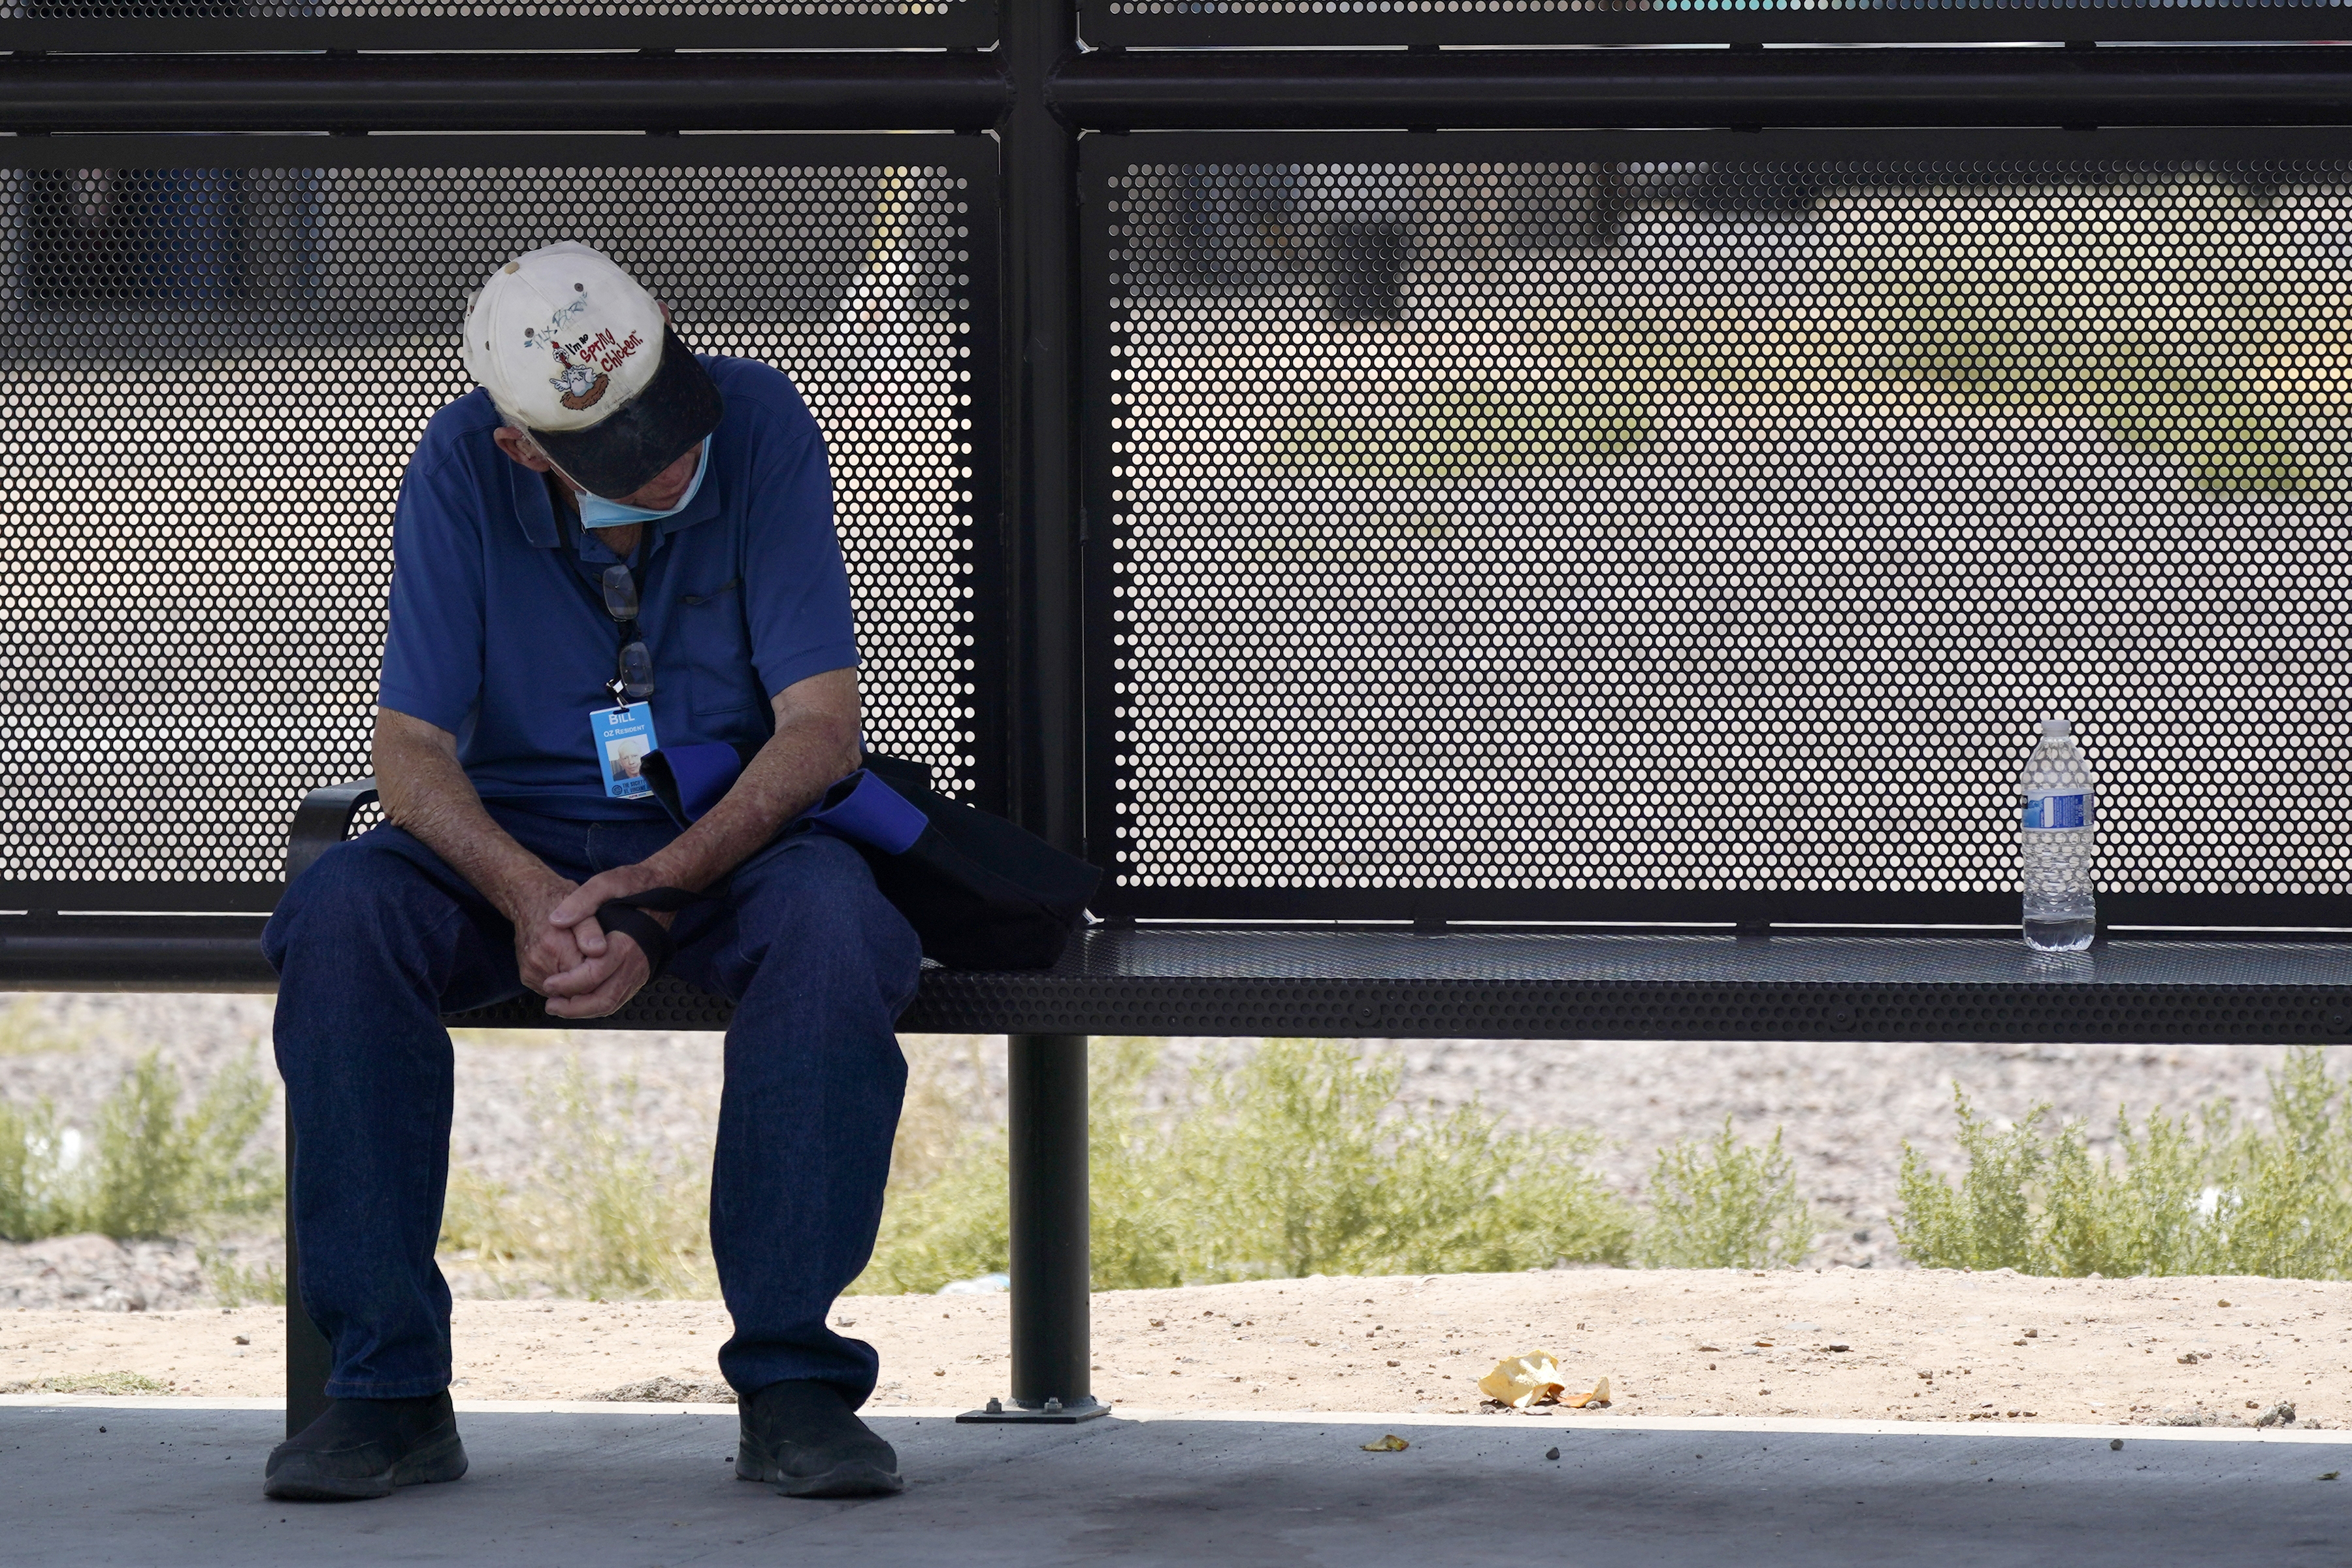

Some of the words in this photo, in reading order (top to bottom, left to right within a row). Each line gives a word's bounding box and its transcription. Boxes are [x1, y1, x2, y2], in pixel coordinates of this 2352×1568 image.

[564, 342, 582, 355] I'm
[579, 334, 589, 345] no
[580, 328, 616, 363] Spring
